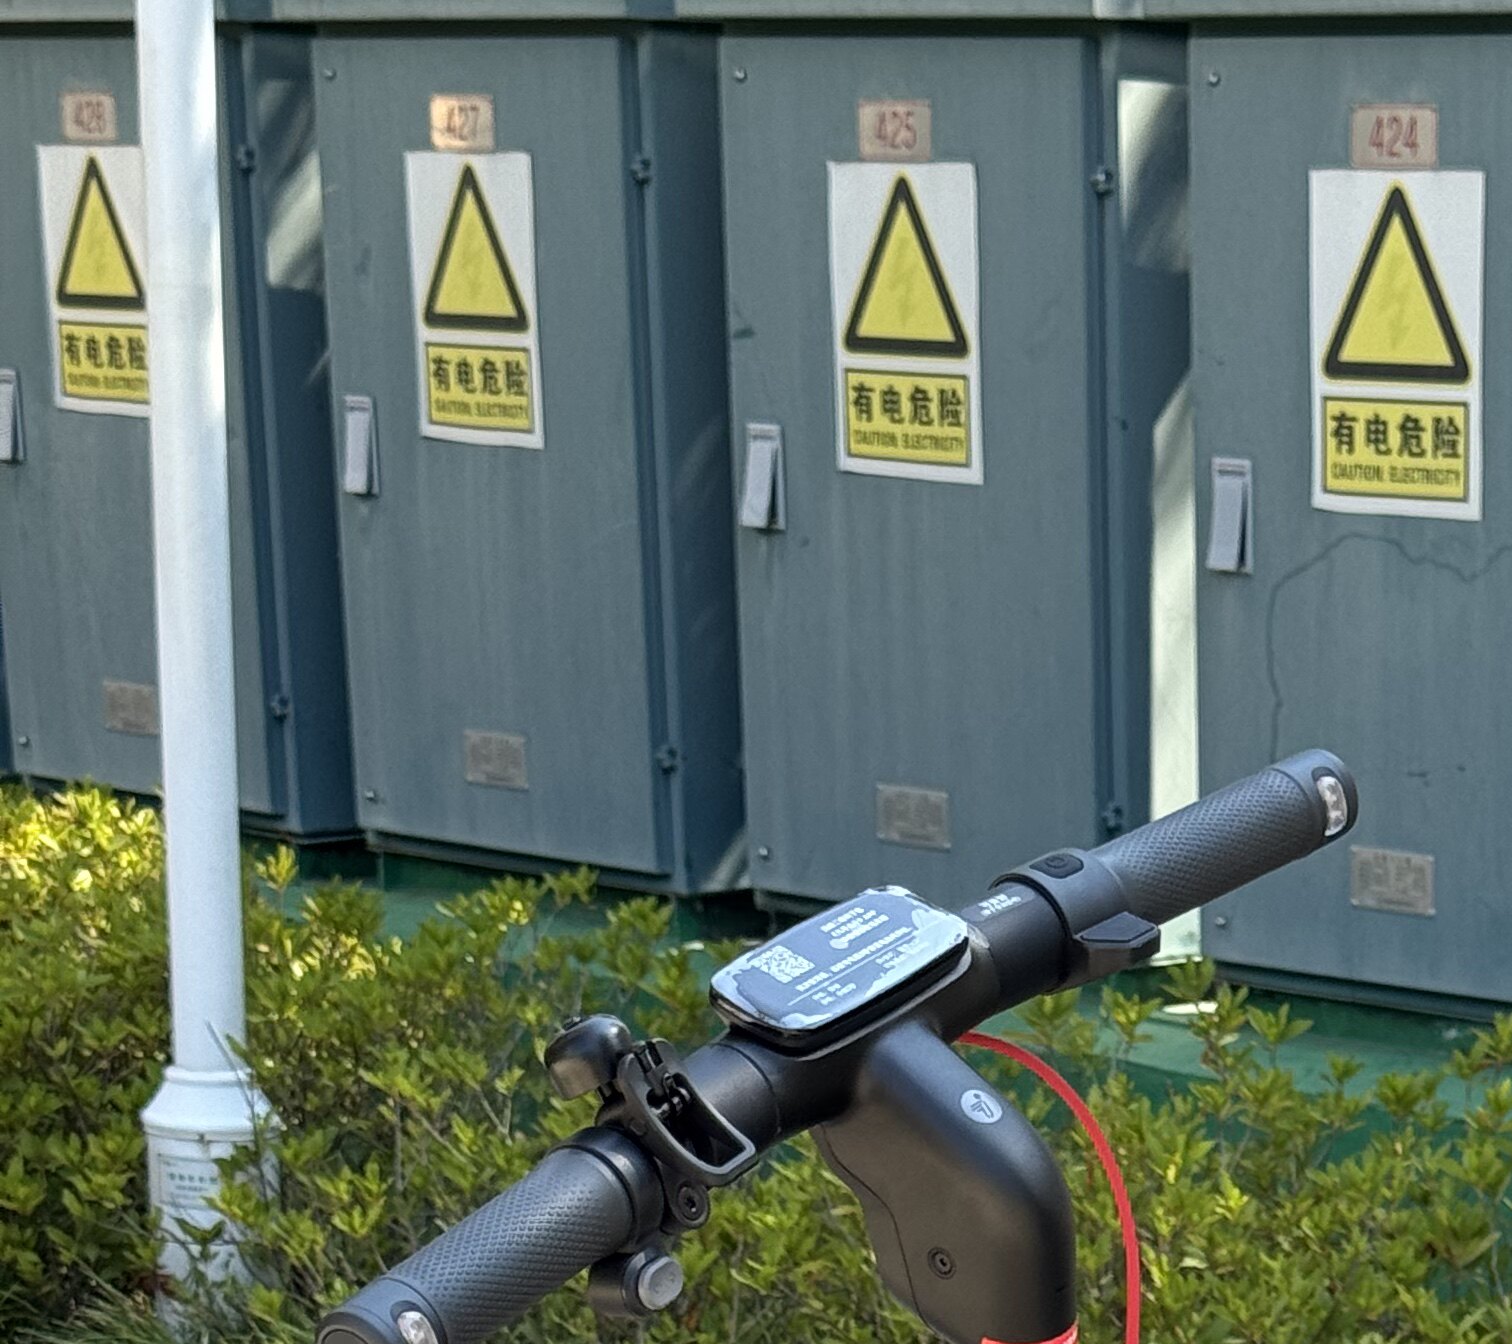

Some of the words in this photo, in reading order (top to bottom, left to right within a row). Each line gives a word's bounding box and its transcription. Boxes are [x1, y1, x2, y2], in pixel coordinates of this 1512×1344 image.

[874, 110, 918, 150] 425
[1368, 114, 1419, 158] 424
[431, 354, 528, 397] 有电危险
[850, 382, 963, 428] 有电危险
[1330, 410, 1462, 460] 有电危险
